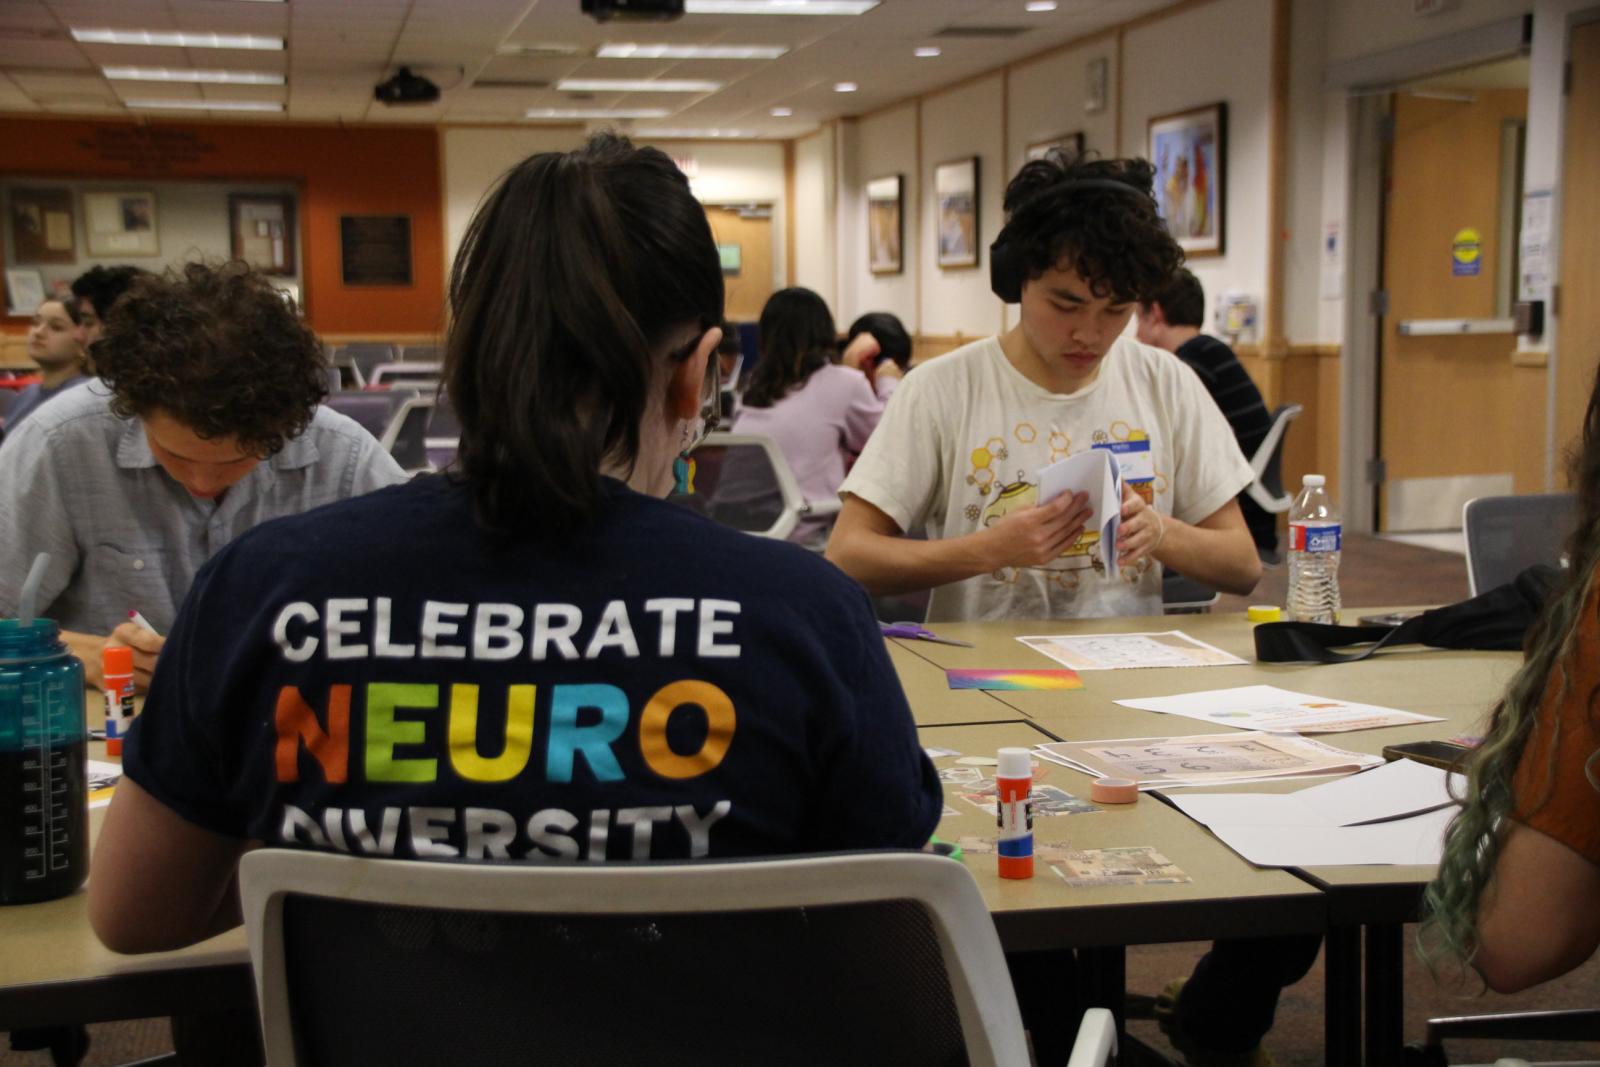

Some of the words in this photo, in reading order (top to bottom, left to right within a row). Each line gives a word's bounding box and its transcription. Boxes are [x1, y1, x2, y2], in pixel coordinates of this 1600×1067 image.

[273, 597, 742, 662] CELEBRATE
[274, 679, 737, 783] NEURO
[280, 800, 732, 859] DIVERSITY
